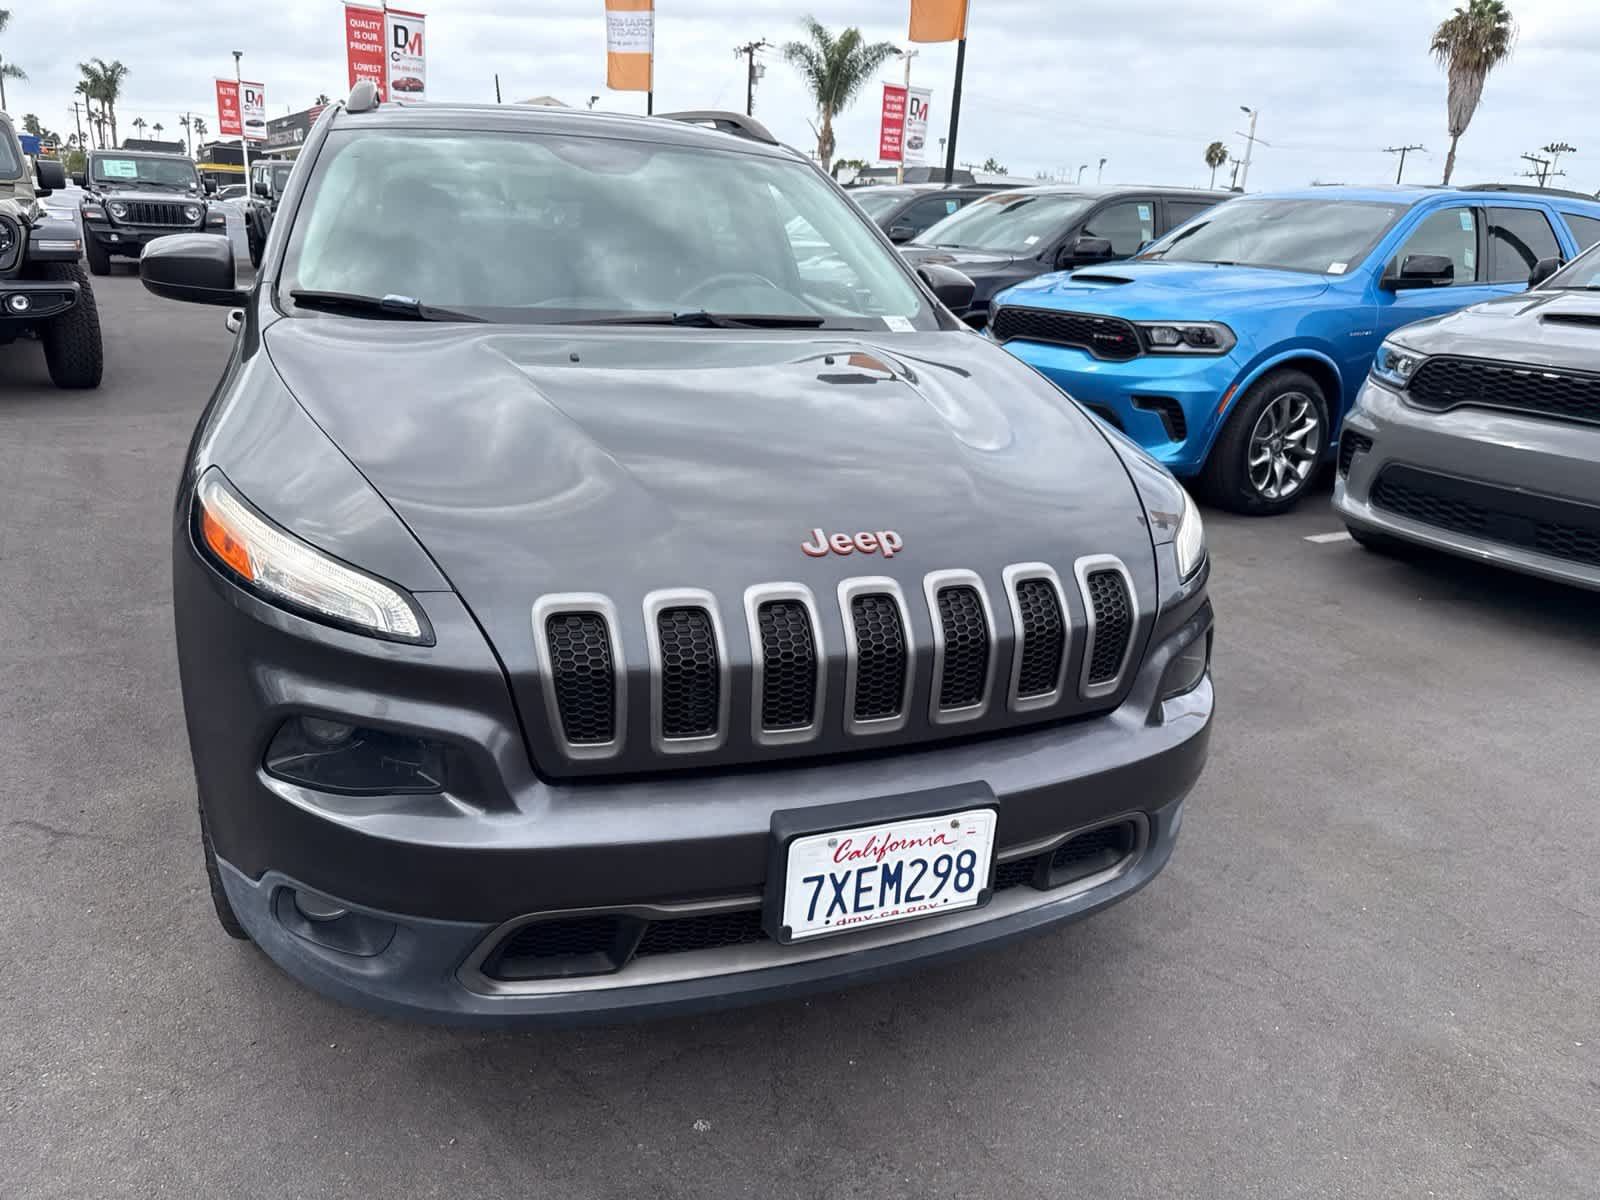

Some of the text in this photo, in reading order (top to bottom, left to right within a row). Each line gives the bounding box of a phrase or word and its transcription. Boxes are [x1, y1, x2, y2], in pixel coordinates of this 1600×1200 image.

[350, 19, 381, 30] QUALITY
[354, 31, 378, 41] IS OUR
[350, 41, 382, 52] PRIORITY
[353, 62, 381, 72] LOWEST
[801, 528, 903, 558] Jeep
[833, 832, 957, 864] California
[802, 849, 977, 922] 7XEM298
